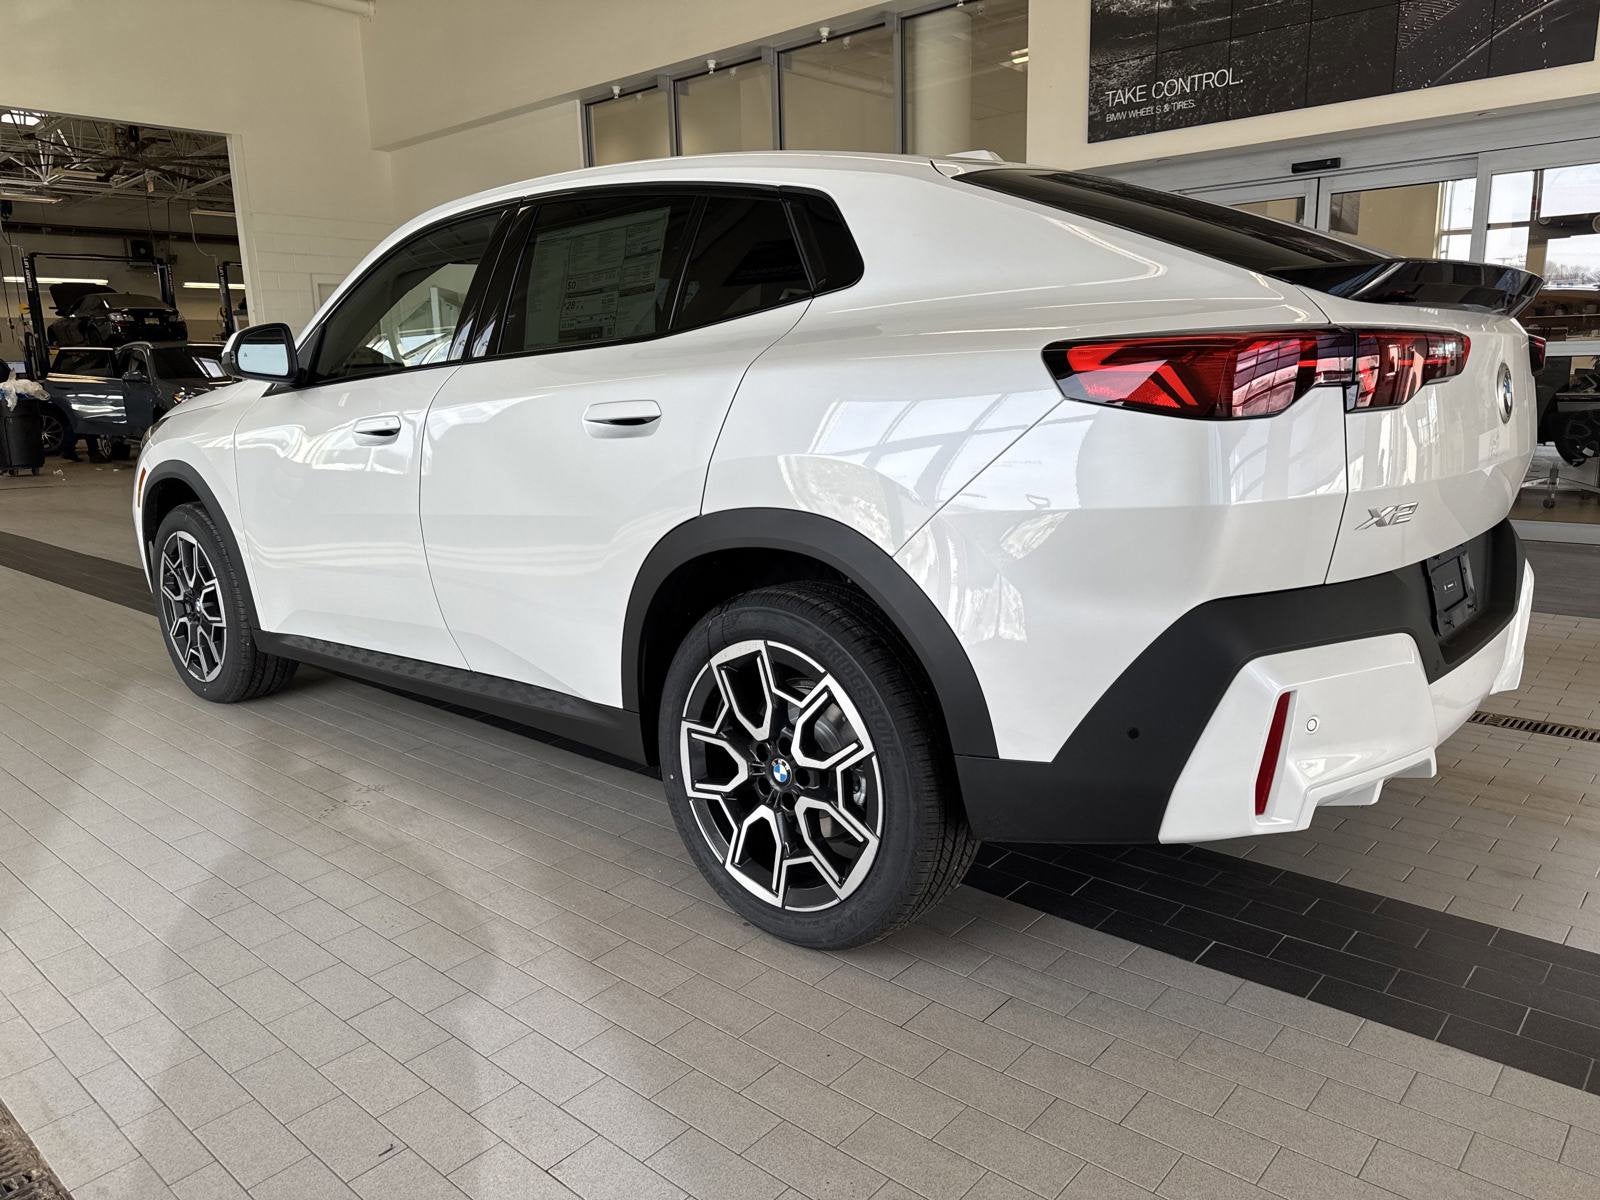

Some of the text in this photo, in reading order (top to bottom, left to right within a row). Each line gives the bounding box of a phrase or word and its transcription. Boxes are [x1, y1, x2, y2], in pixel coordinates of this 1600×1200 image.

[1105, 67, 1244, 107] TAKE CONTROL.
[1106, 111, 1127, 123] BMW
[1128, 105, 1162, 118] WHEELS
[1163, 103, 1170, 113] &
[1354, 502, 1419, 527] X2
